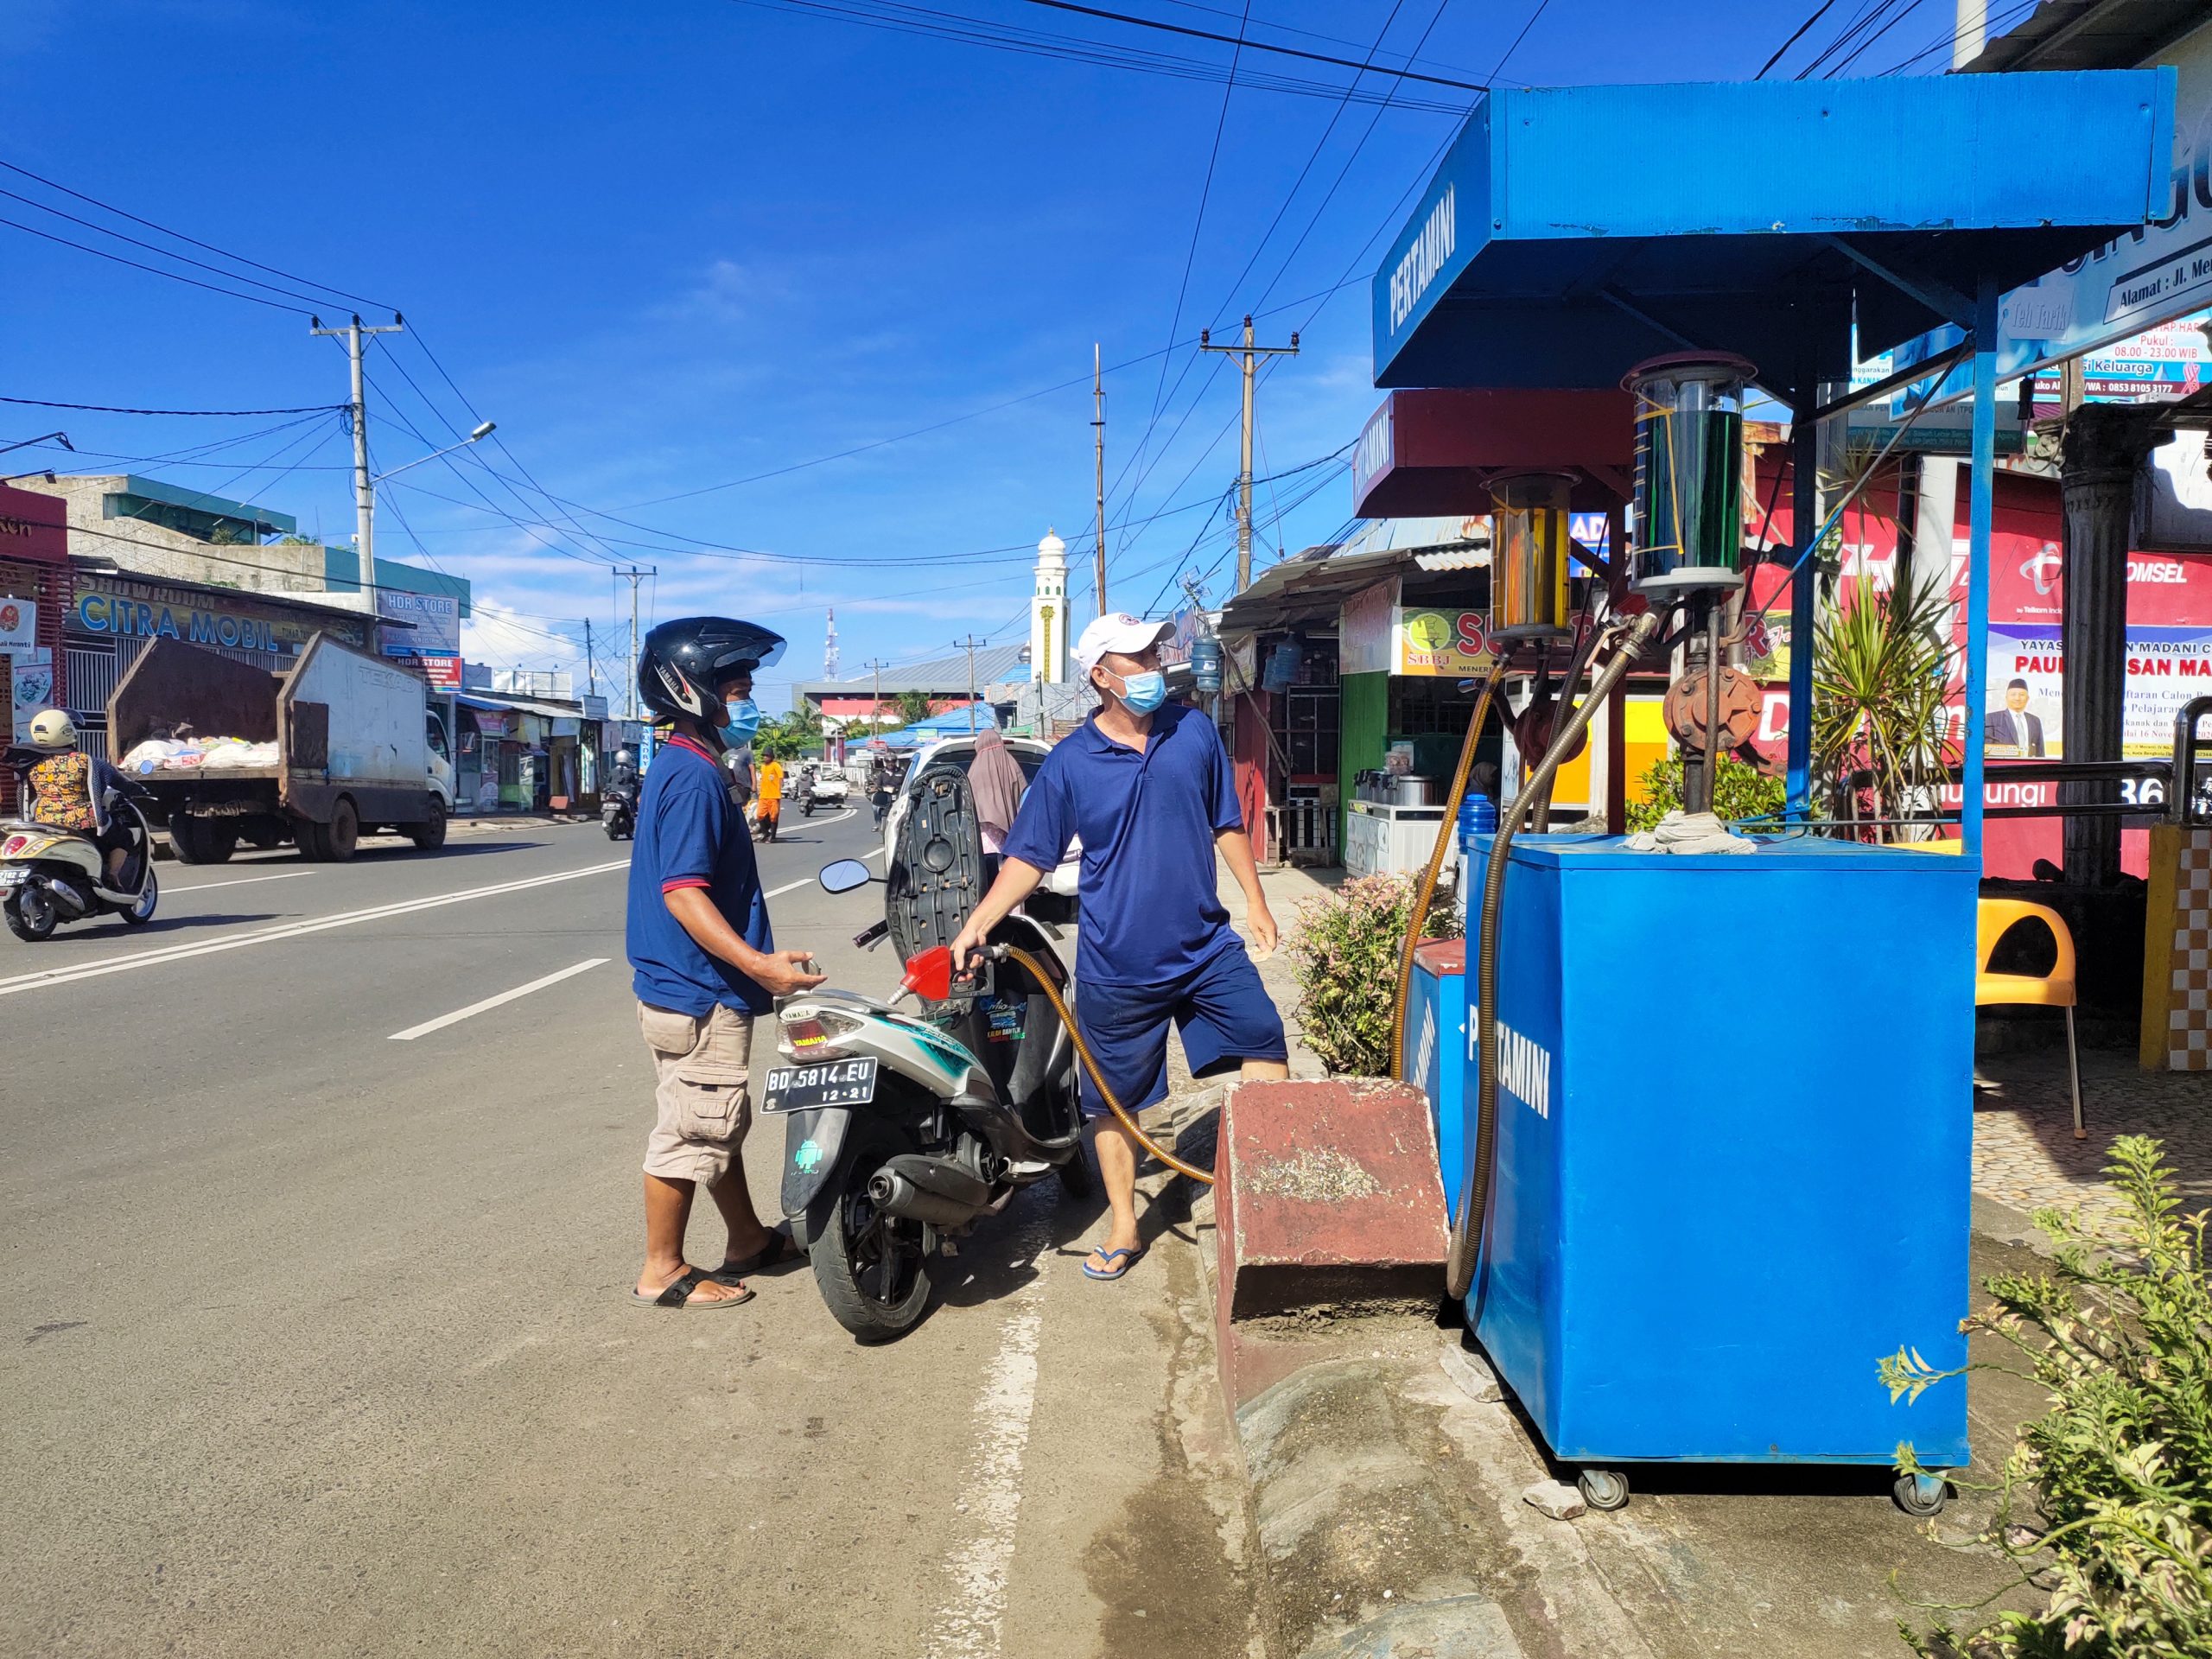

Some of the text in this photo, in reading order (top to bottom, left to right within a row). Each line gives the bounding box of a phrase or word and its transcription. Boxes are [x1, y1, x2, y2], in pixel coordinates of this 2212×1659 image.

[1390, 181, 1455, 337] PERTAMINI
[2120, 280, 2161, 308] Alamat
[2173, 268, 2187, 287] Jl.
[2012, 302, 2069, 332] Teh Tarik
[2140, 335, 2168, 346] Pukul
[2114, 346, 2142, 357] 08.00
[2150, 347, 2177, 358] 23.00
[2179, 347, 2197, 359] WIB
[2094, 361, 2153, 375] Keluarga
[2034, 380, 2050, 390] uko
[2084, 382, 2101, 391] /WA
[2108, 384, 2129, 393] 0853
[2131, 384, 2152, 392] 8105
[2152, 385, 2173, 393] 3177
[2126, 563, 2188, 584] OMSEL
[388, 594, 453, 614] HDR STORE
[2024, 606, 2048, 614] Telkom
[79, 594, 278, 652] CITRA MOBIL
[2020, 639, 2063, 651] YAYAS
[2139, 642, 2197, 654] MADANI
[397, 657, 454, 668] HDR STORE
[1407, 654, 1452, 666] SBBJ
[2015, 655, 2212, 677] PAU SAN MA
[1458, 664, 1492, 673] MENERI
[658, 664, 679, 692] YAMAHA
[2038, 687, 2063, 698] Men
[2126, 690, 2158, 699] ftaran
[2162, 690, 2192, 700] Calon
[785, 1009, 810, 1020] YAMAHA
[793, 1035, 828, 1047] YAMAHA
[1469, 1004, 1550, 1120] PTAMINI
[768, 1062, 869, 1091] BD 5814 EU
